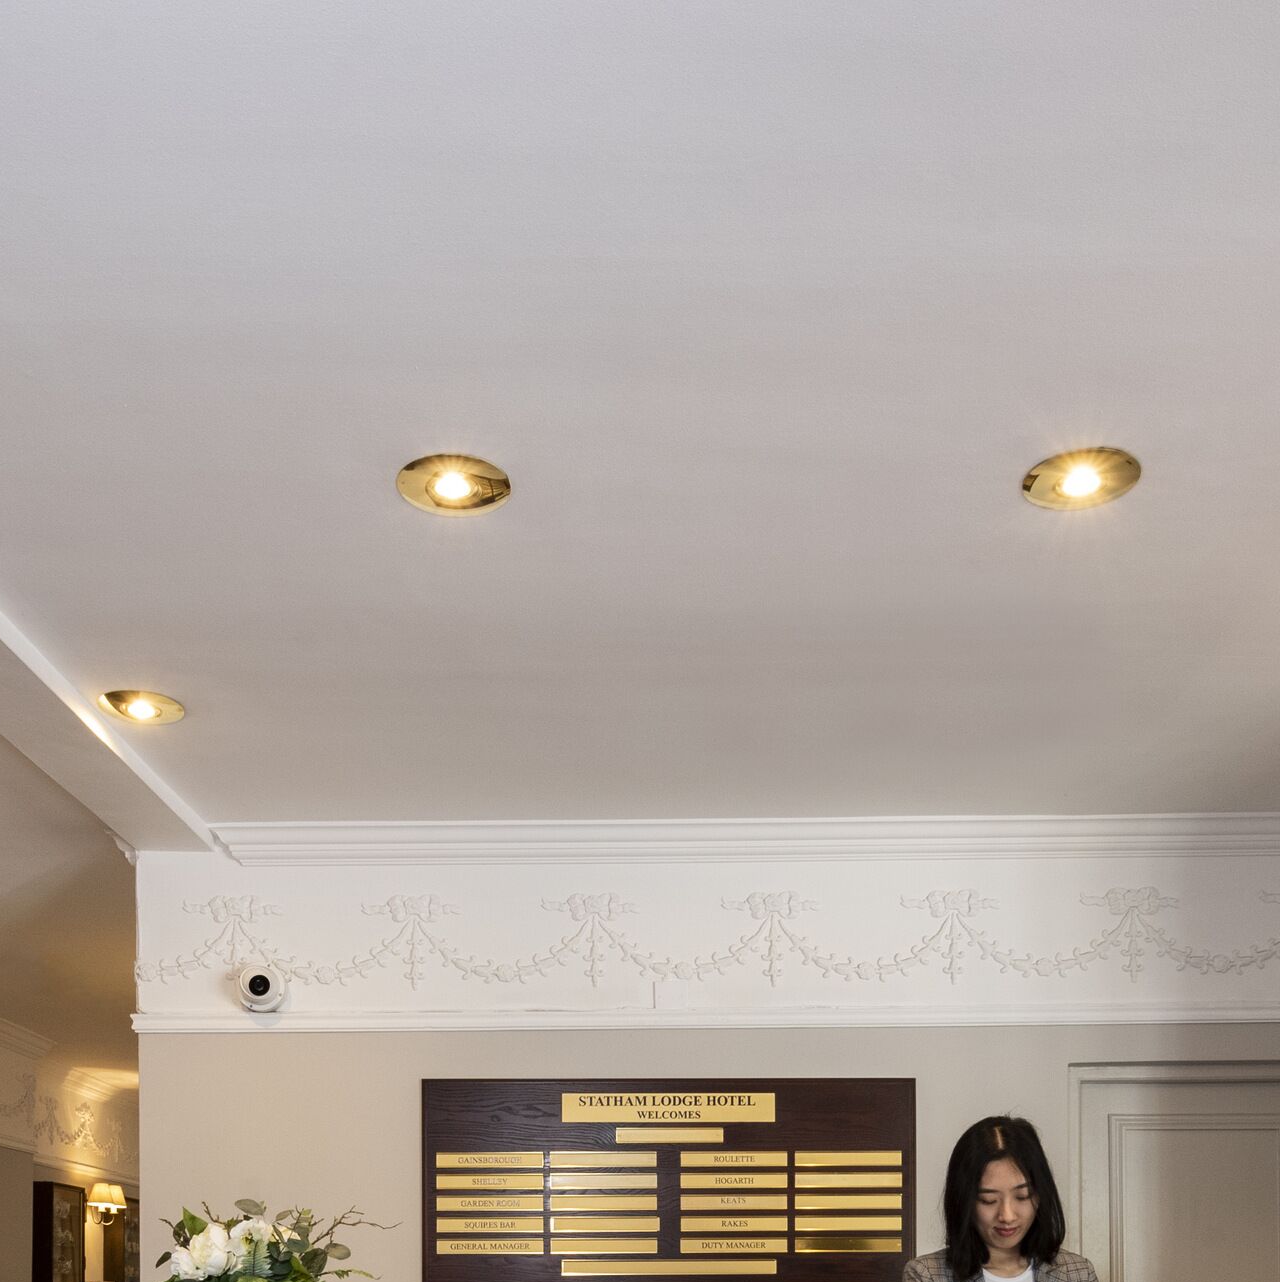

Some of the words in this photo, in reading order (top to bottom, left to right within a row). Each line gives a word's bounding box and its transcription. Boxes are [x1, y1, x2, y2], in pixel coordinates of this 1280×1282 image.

[578, 1095, 647, 1107] STATHAM
[652, 1095, 702, 1107] LODGE
[706, 1095, 756, 1107] HOTEL
[636, 1110, 701, 1119] WELCOMES
[457, 1156, 522, 1164] GAINSBOROUGH
[713, 1155, 755, 1163] ROULETTE
[715, 1177, 754, 1185] HOGARTH
[464, 1221, 498, 1229] SQUIRES
[499, 1221, 516, 1229] BAR
[489, 1242, 530, 1250] MANAGER
